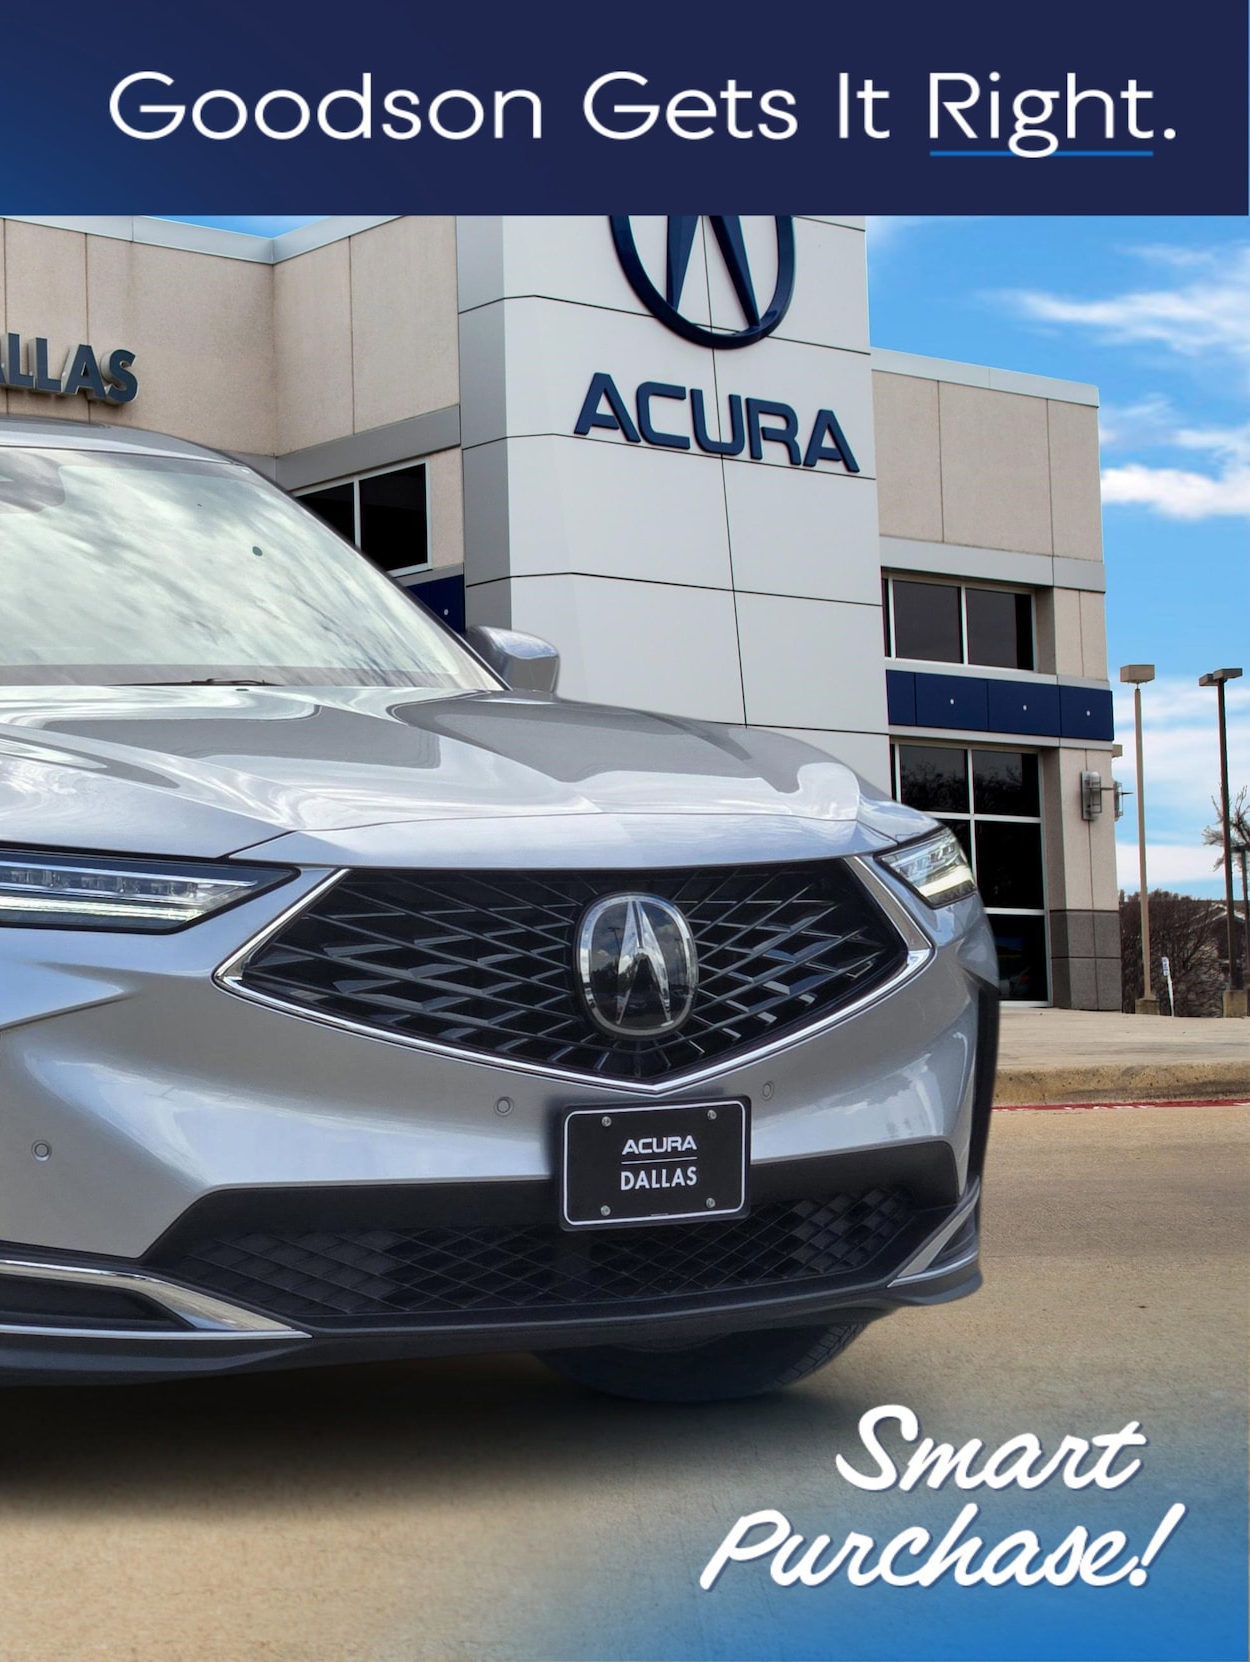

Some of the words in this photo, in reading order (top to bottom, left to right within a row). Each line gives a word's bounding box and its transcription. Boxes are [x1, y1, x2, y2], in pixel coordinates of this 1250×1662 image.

[573, 372, 860, 473] ACURA
[621, 1134, 698, 1156] ACURA
[620, 1166, 698, 1191] DALLAS
